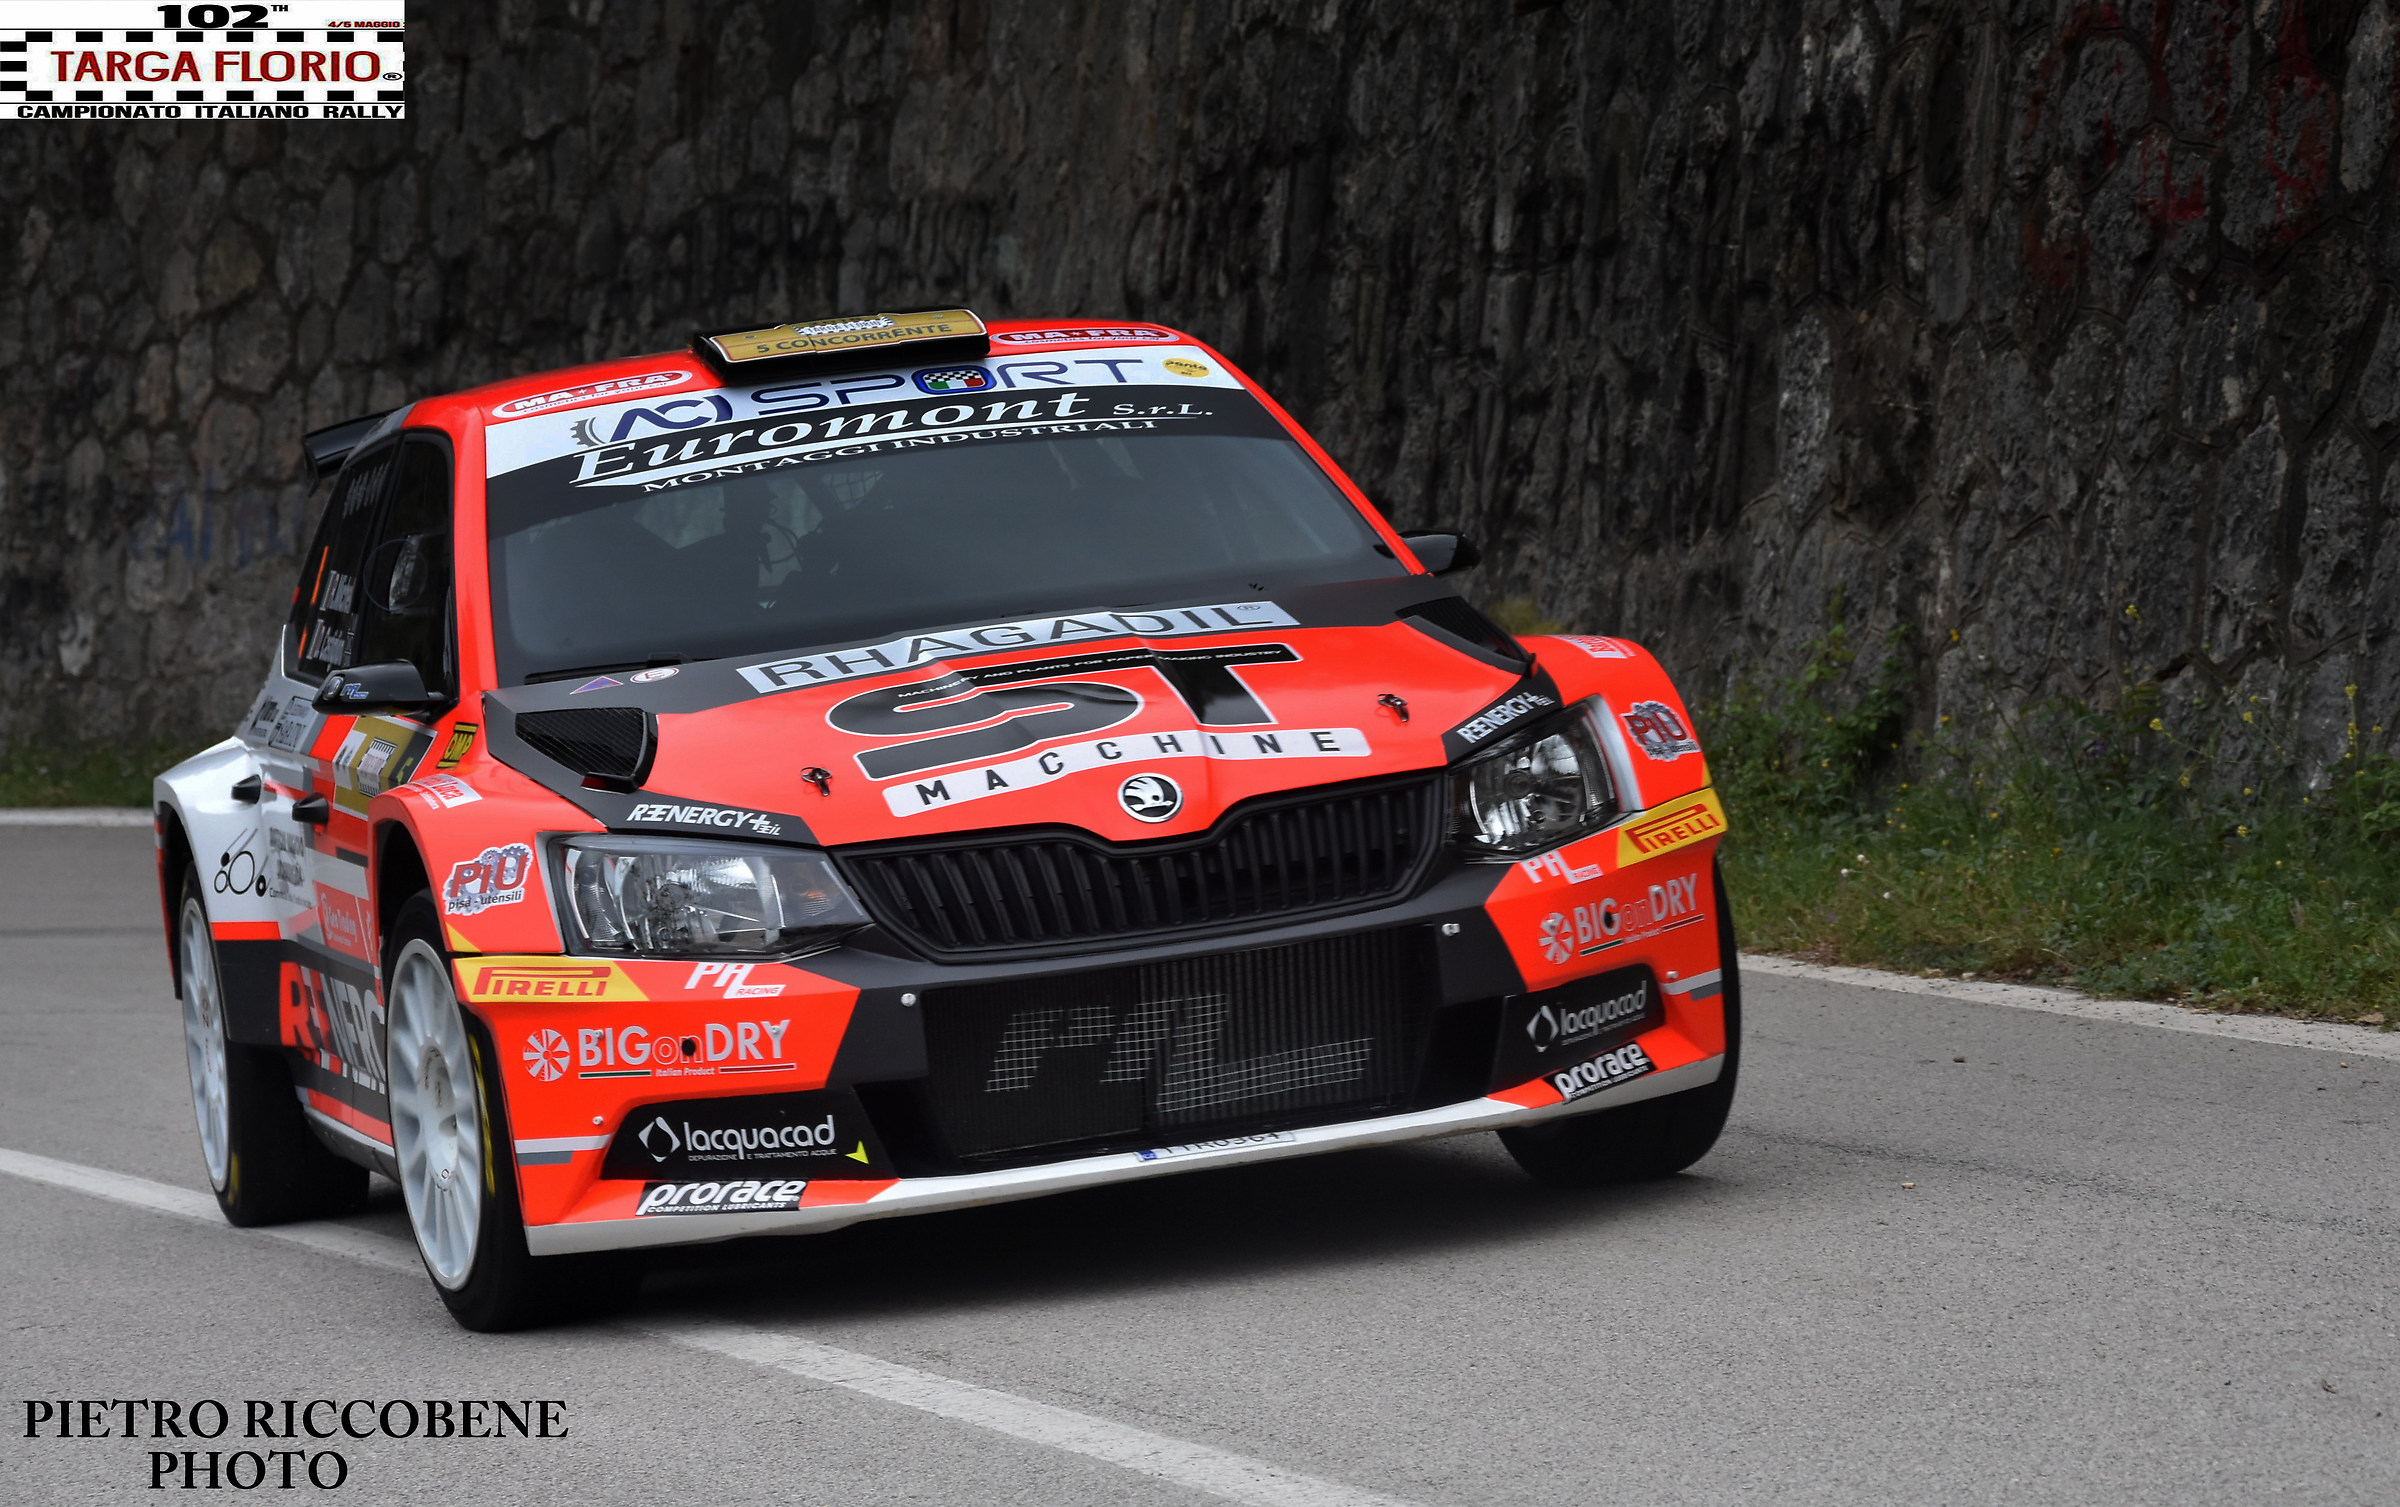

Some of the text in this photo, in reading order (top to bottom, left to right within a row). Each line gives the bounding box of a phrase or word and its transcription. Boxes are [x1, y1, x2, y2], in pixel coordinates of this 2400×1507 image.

[775, 324, 953, 350] CONCORRENTE
[569, 391, 1090, 484] Euromont
[642, 420, 1159, 493] MONTAGGI INDUSTRIALI
[897, 675, 979, 698] MACHINERY
[983, 670, 1013, 679] AND
[1017, 663, 1070, 673] PLANTS
[1074, 658, 1103, 666] FOR
[1106, 654, 1154, 662] PAPER
[1215, 650, 1282, 658] INDUSTRY
[915, 730, 1342, 806] MACCHINE
[1624, 803, 1721, 854] PIRELLI
[448, 891, 521, 911] pisa utensili
[472, 966, 611, 996] PIRELLI
[736, 987, 780, 995] RACING
[1561, 980, 1647, 1036] lacquacad
[656, 1067, 715, 1077] Italian Product
[1555, 1042, 1650, 1102] prorace
[683, 1115, 836, 1160] lacquacad
[688, 1154, 738, 1162] DEPURAZIONE
[754, 1151, 809, 1159] TRATTAMENTO
[636, 1181, 807, 1215] prorace
[648, 1202, 787, 1213] COMPETITION LUBRICANTS
